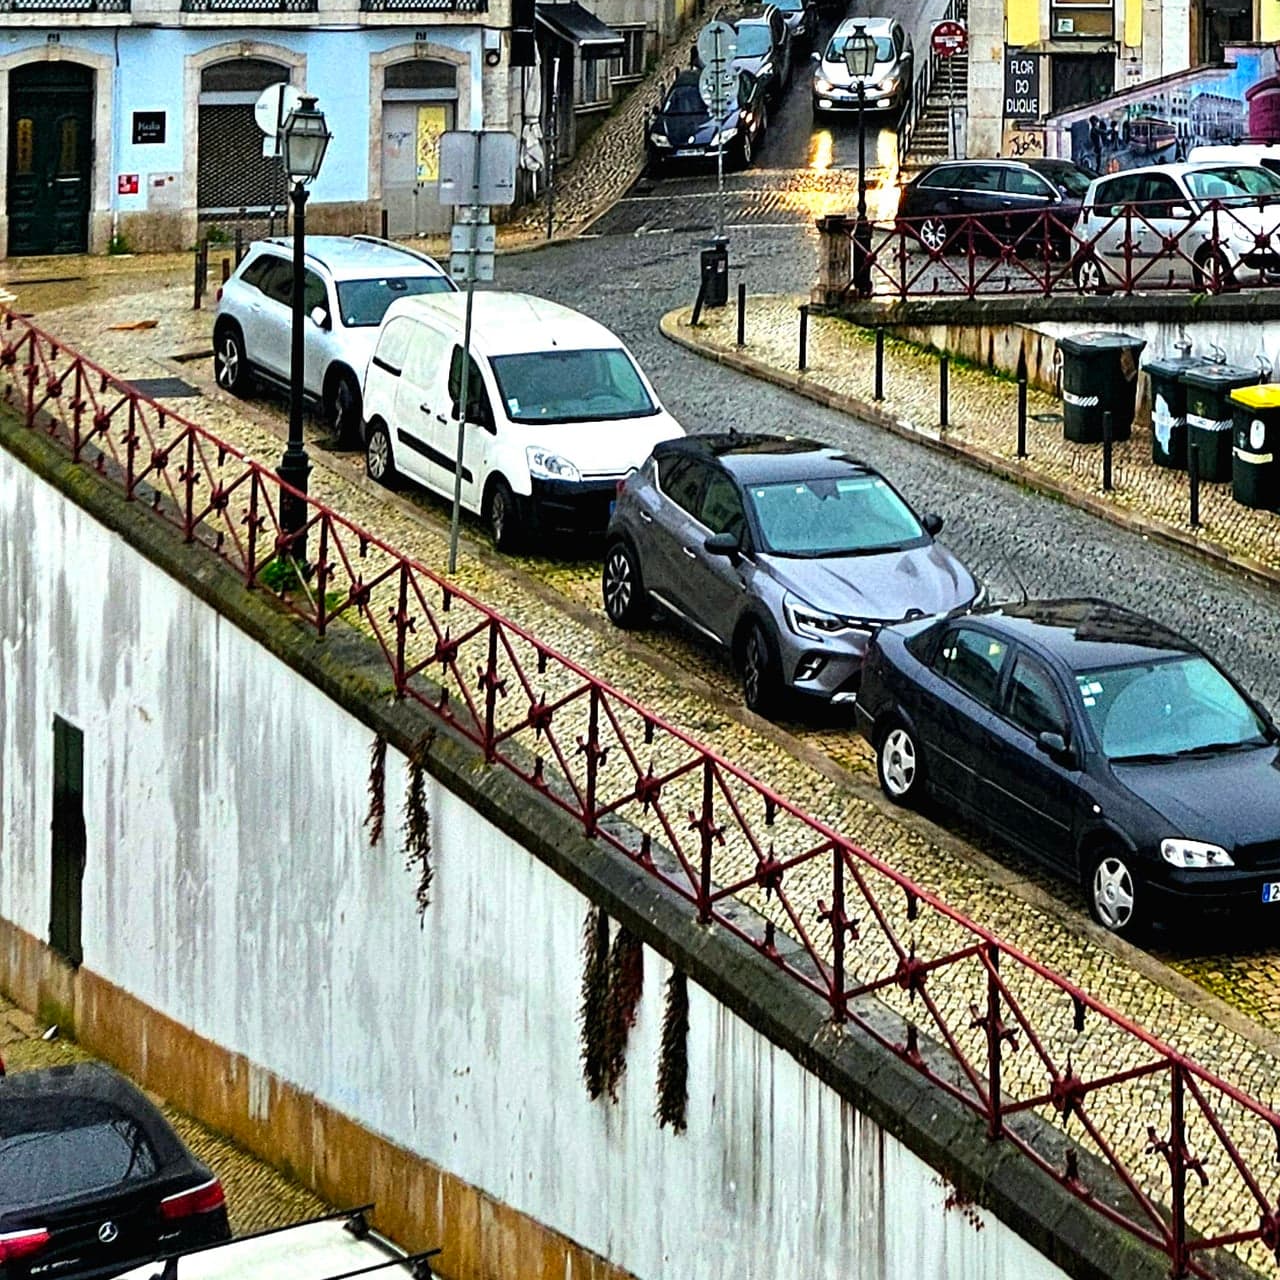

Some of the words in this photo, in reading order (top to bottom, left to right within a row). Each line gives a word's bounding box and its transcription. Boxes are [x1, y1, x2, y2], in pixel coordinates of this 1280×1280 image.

[1011, 60, 1034, 75] FLOR
[1015, 79, 1030, 94] DO
[1006, 98, 1038, 114] DUQUE
